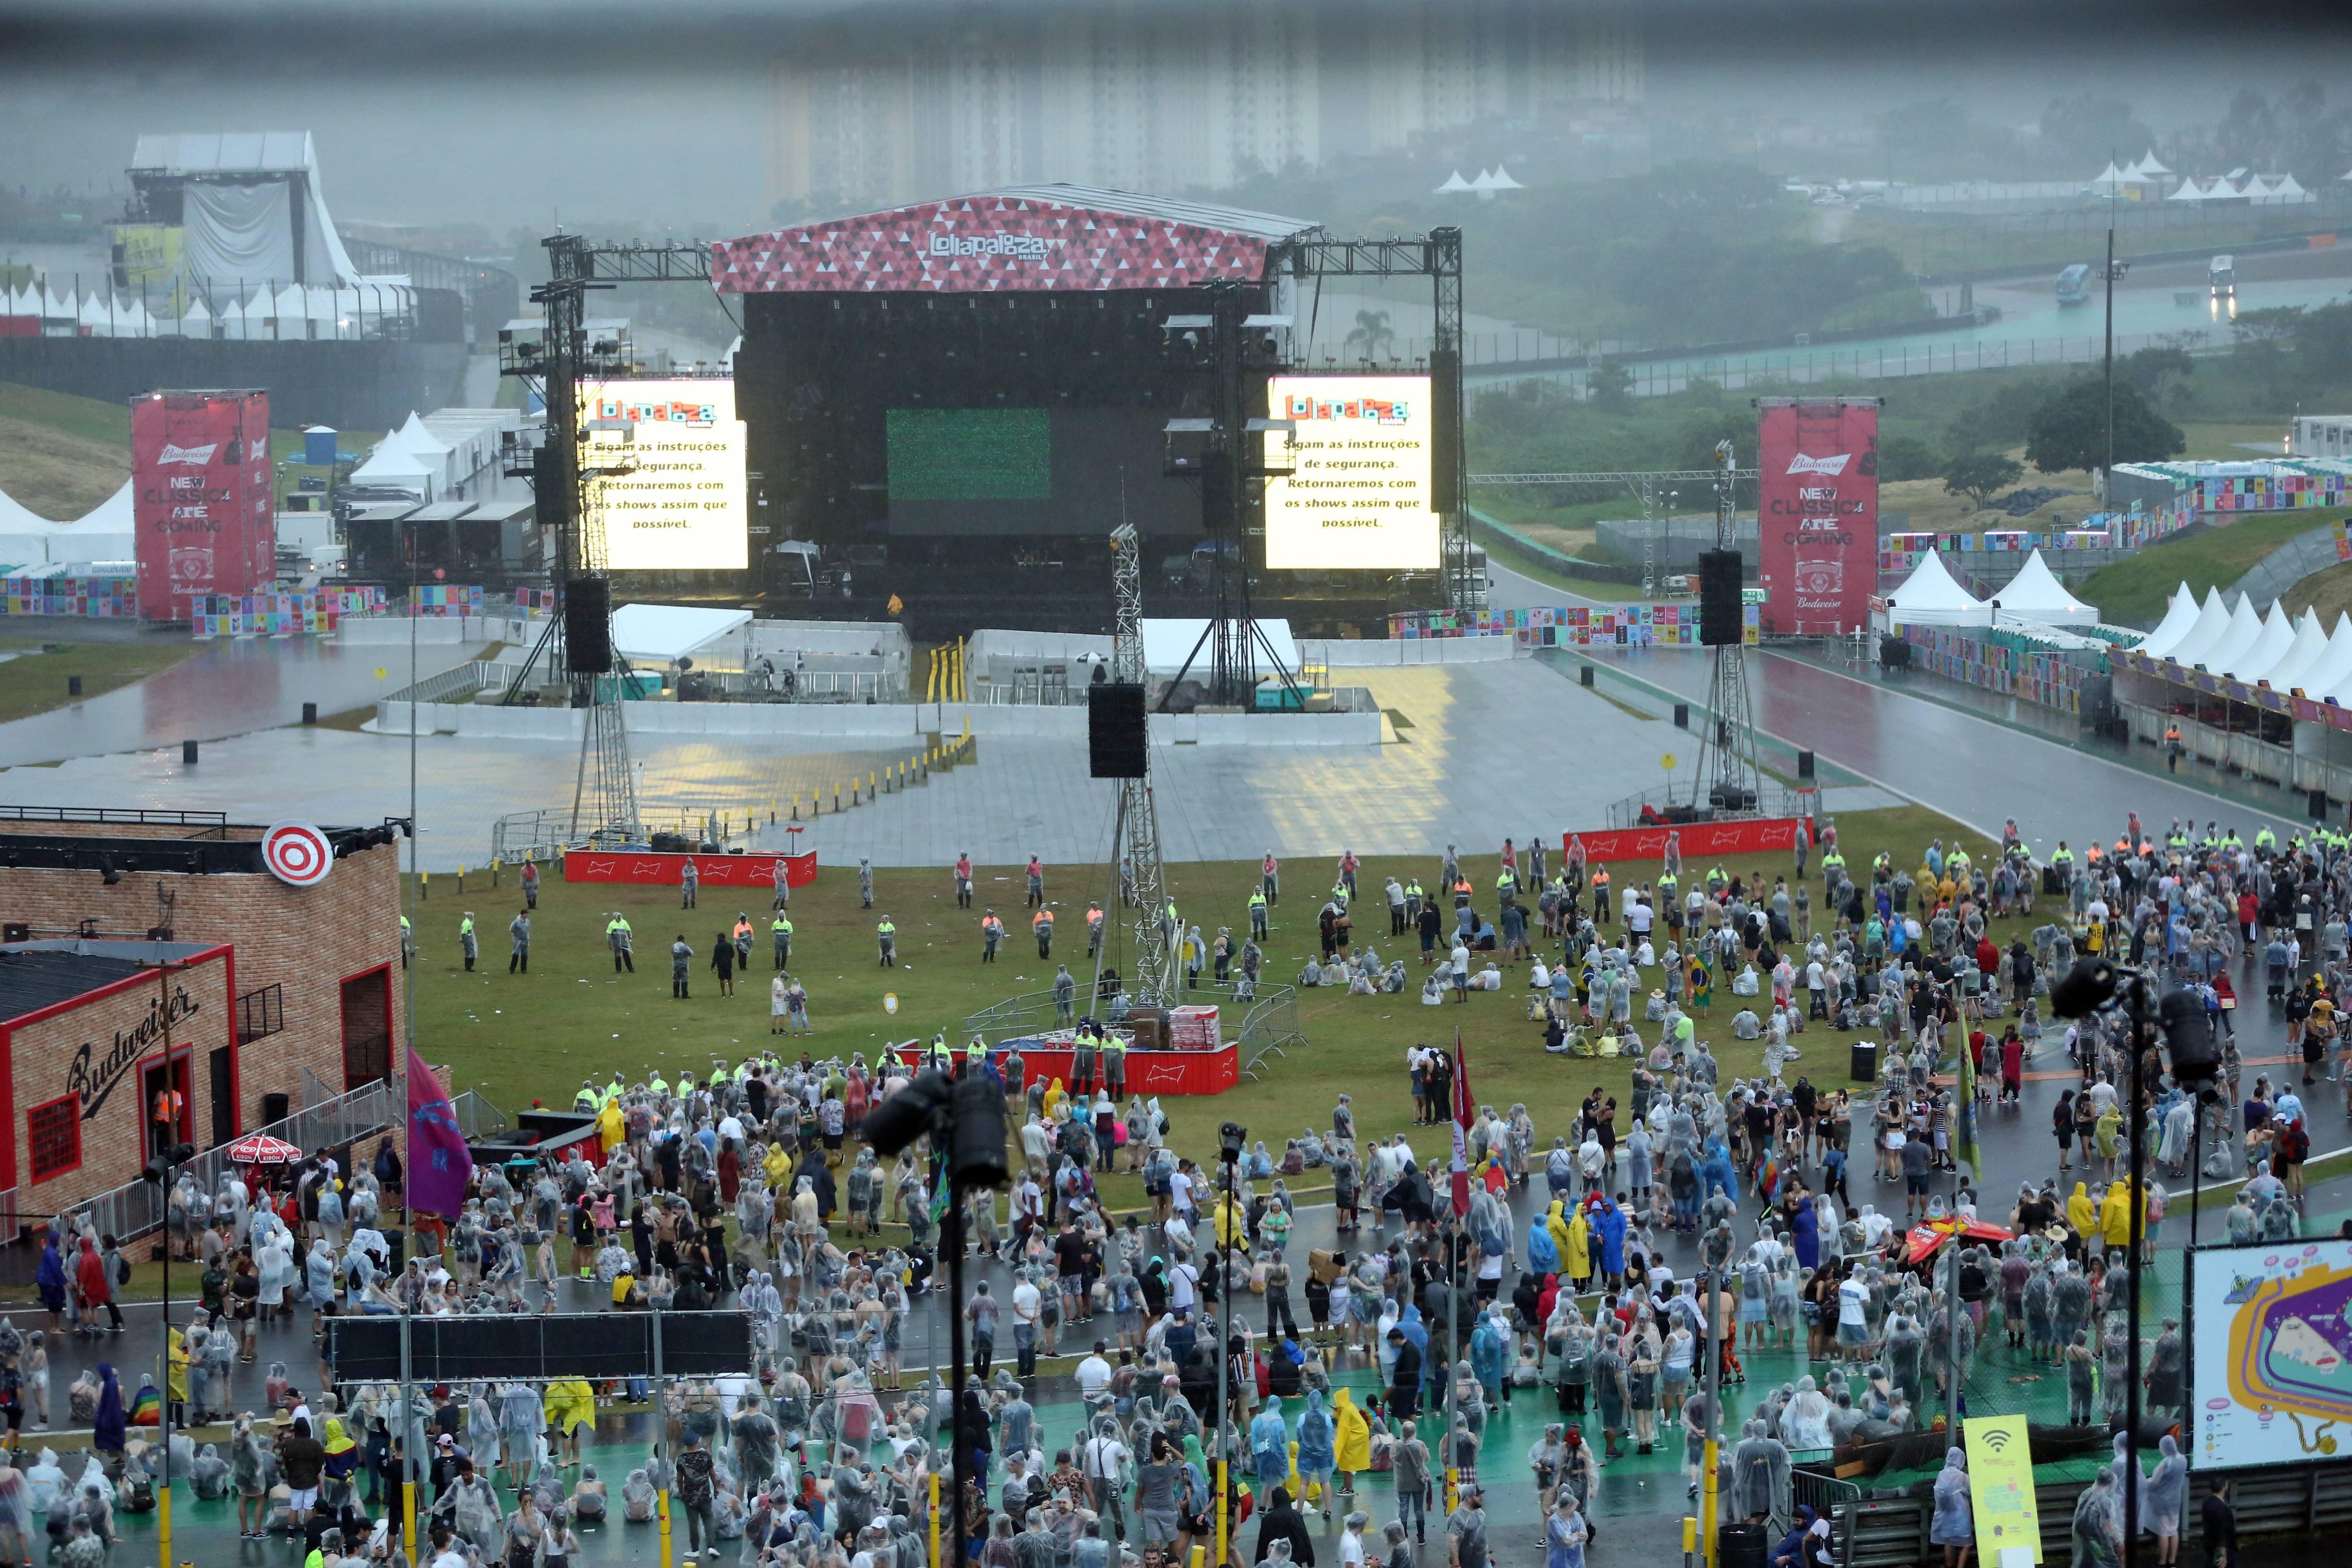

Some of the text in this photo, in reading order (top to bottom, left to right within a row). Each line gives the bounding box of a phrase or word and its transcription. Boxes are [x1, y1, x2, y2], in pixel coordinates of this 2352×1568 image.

[929, 232, 1049, 258] Lollapalooza
[1286, 395, 1411, 421] Lollapalooza
[594, 441, 727, 453] Sigam as instruções
[1283, 439, 1324, 451] Sigam
[1348, 439, 1420, 450] instruções
[162, 448, 212, 459] Budweiser
[635, 462, 706, 473] segurança.
[1305, 459, 1399, 471] de segurança.
[1792, 458, 1845, 469] Budweiser
[170, 477, 206, 489] NEW
[599, 481, 692, 490] Retornaremos
[1287, 479, 1384, 488] Retornaremos
[1800, 487, 1838, 500] NEW
[598, 500, 727, 511] s shows assim que
[1285, 498, 1420, 509] os shows assim que
[157, 519, 222, 533] COMING
[633, 518, 692, 529] possível.
[1322, 517, 1382, 527] possível.
[1784, 532, 1853, 546] COMING
[67, 985, 199, 1106] Budweiser
[1914, 1226, 1937, 1237] Doritos
